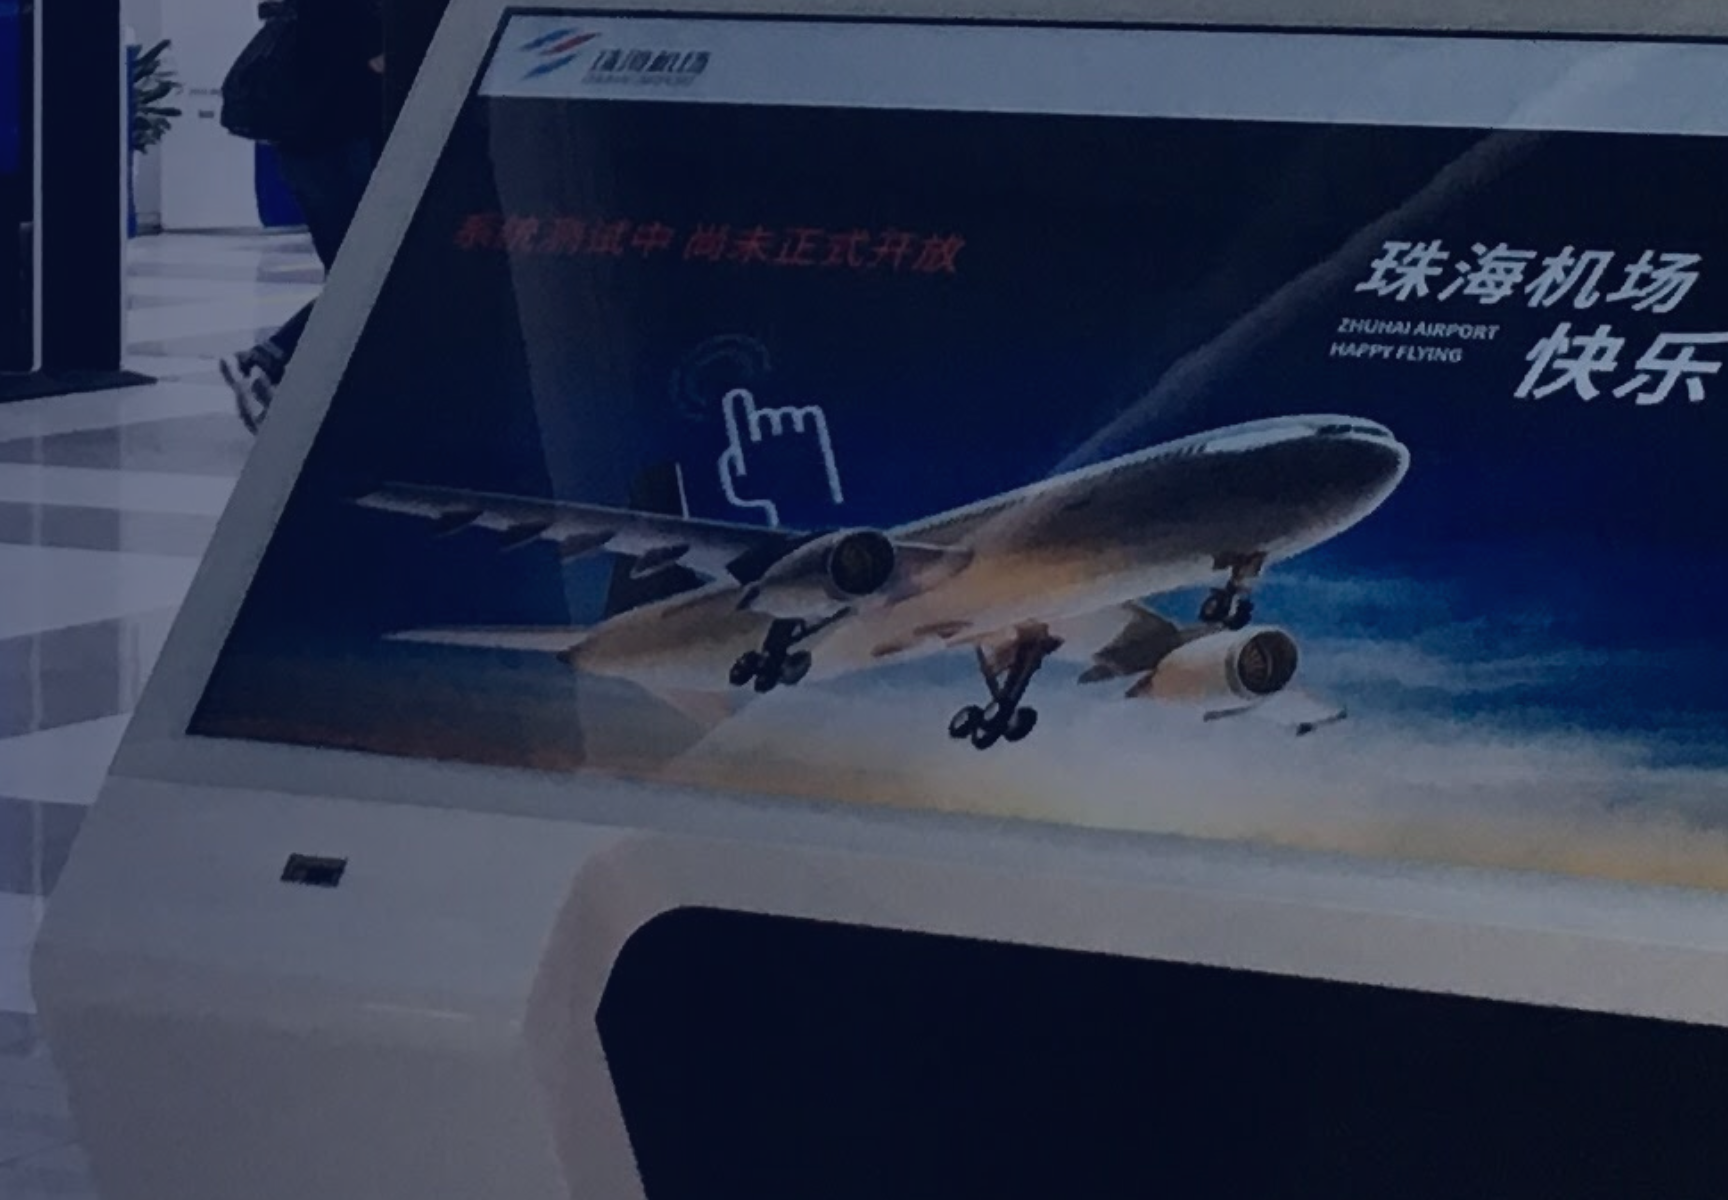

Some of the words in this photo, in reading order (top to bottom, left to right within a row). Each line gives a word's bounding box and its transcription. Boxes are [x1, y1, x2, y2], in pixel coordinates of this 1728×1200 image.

[682, 220, 966, 275] 尚未正式开放
[1354, 237, 1703, 314] 珠海机场
[1336, 316, 1412, 337] ZHUHAI
[1413, 320, 1501, 341] AIRPORT
[1329, 341, 1395, 360] HAPPY
[1396, 345, 1464, 364] FLYING
